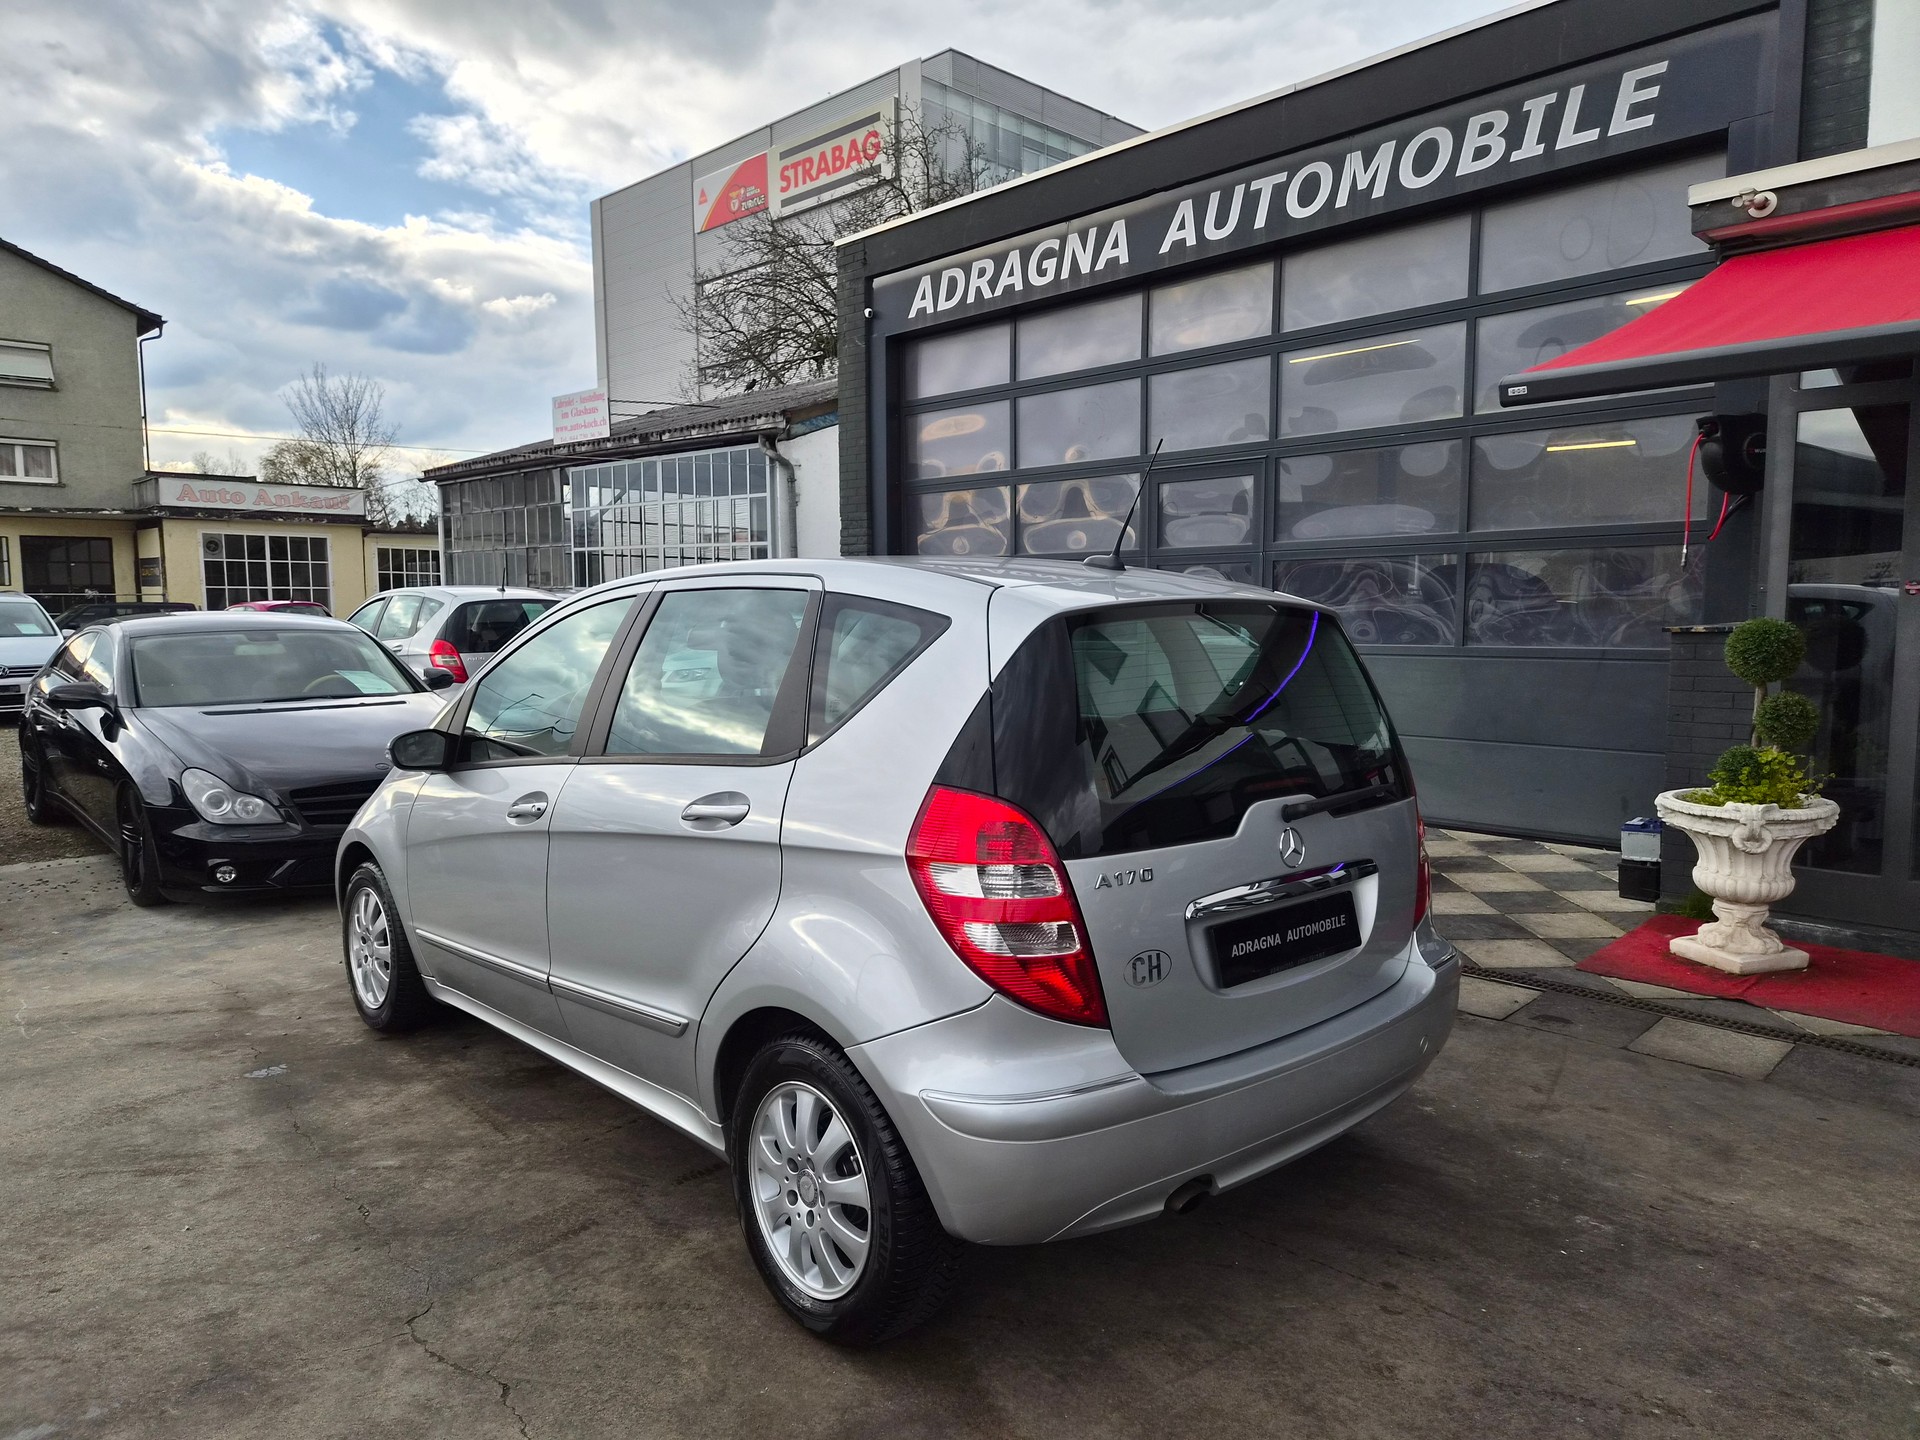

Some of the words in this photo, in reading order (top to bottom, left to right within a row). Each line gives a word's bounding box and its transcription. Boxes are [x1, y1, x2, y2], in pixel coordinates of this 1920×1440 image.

[779, 129, 881, 193] STRABAG
[908, 218, 1129, 318] ADRAGNA
[1158, 60, 1669, 255] AUTOMOBILE
[555, 416, 608, 433] www.auto-koch.ch
[176, 484, 247, 505] Auto
[253, 488, 351, 511] Ankauf
[1094, 867, 1154, 890] A170
[1231, 932, 1282, 958] ADRAGNA
[1286, 914, 1347, 943] AUTOMOBILE
[1131, 952, 1162, 987] CH
